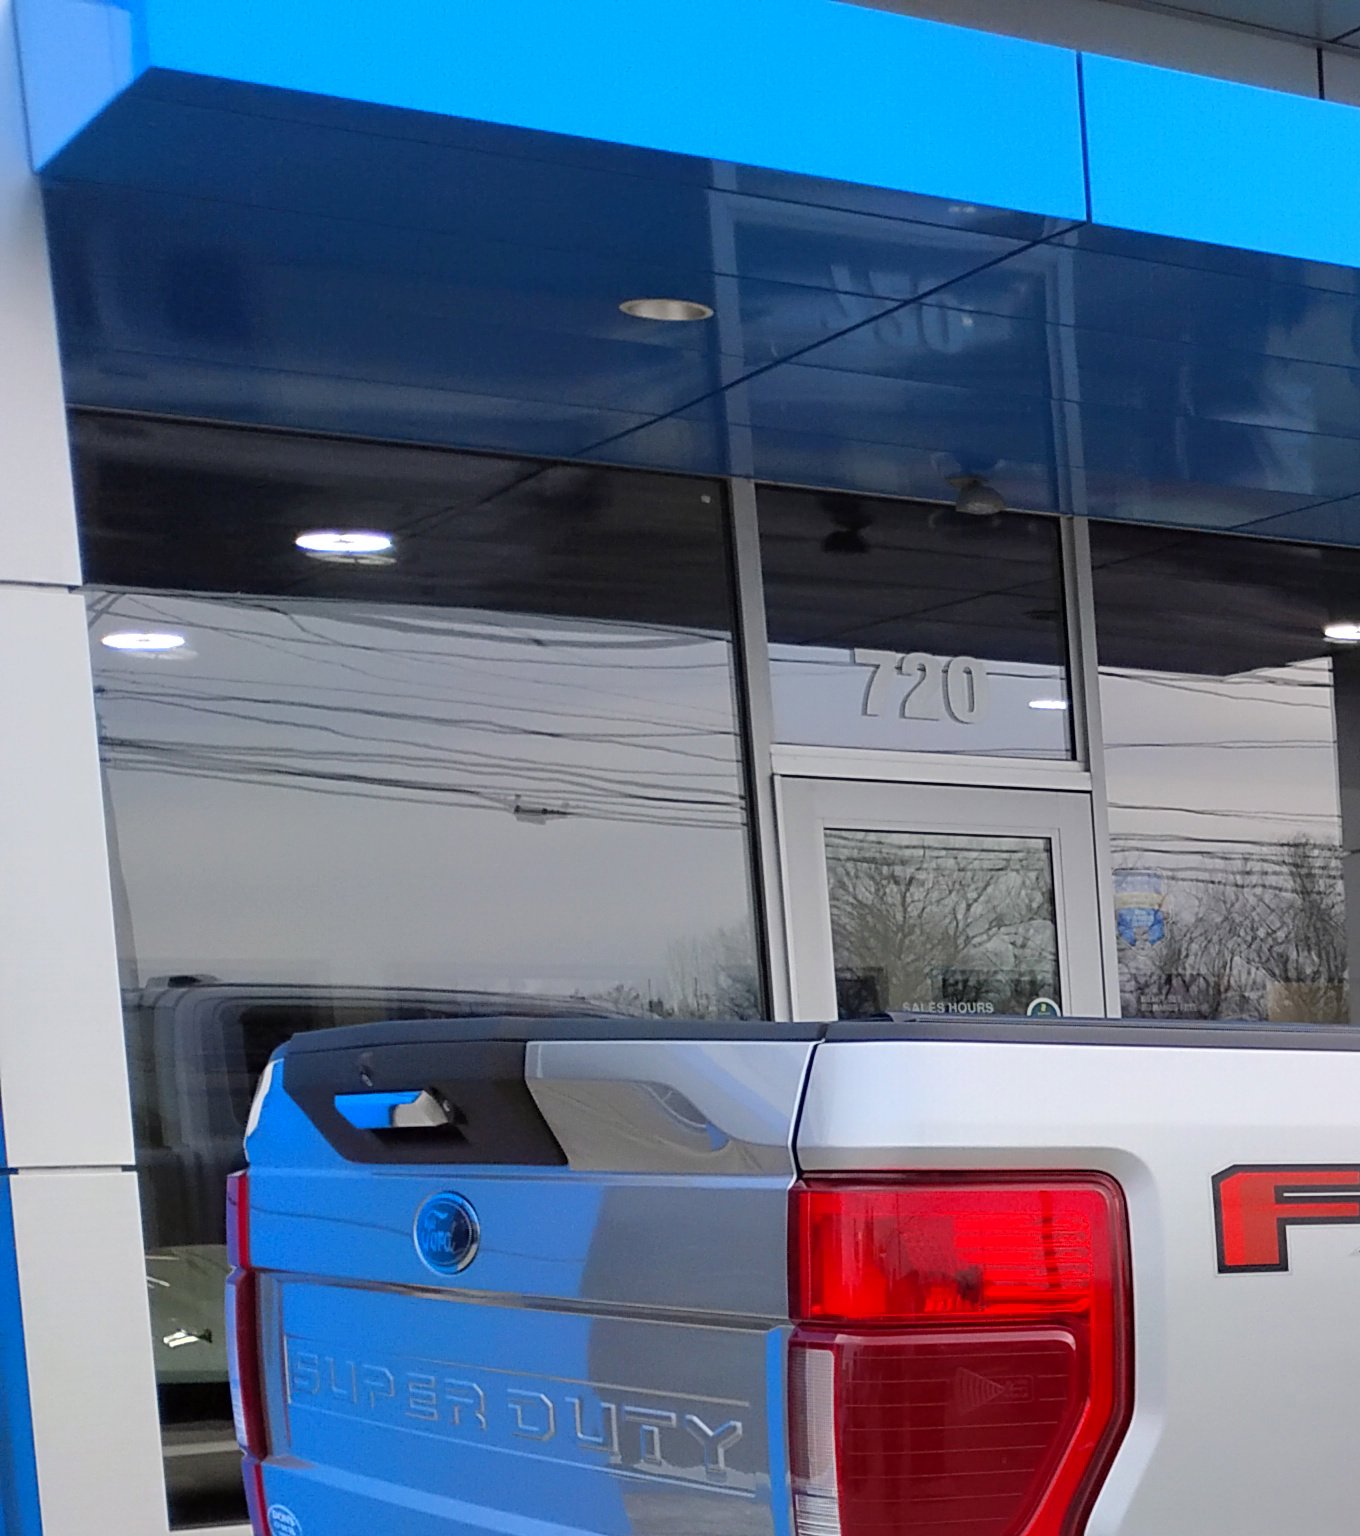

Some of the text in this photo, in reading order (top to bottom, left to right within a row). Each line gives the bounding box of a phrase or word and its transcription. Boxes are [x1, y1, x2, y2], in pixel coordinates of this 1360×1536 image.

[852, 648, 987, 724] 720
[902, 1002, 994, 1014] SALES HOURS
[291, 1350, 744, 1480] SUPER DUTY
